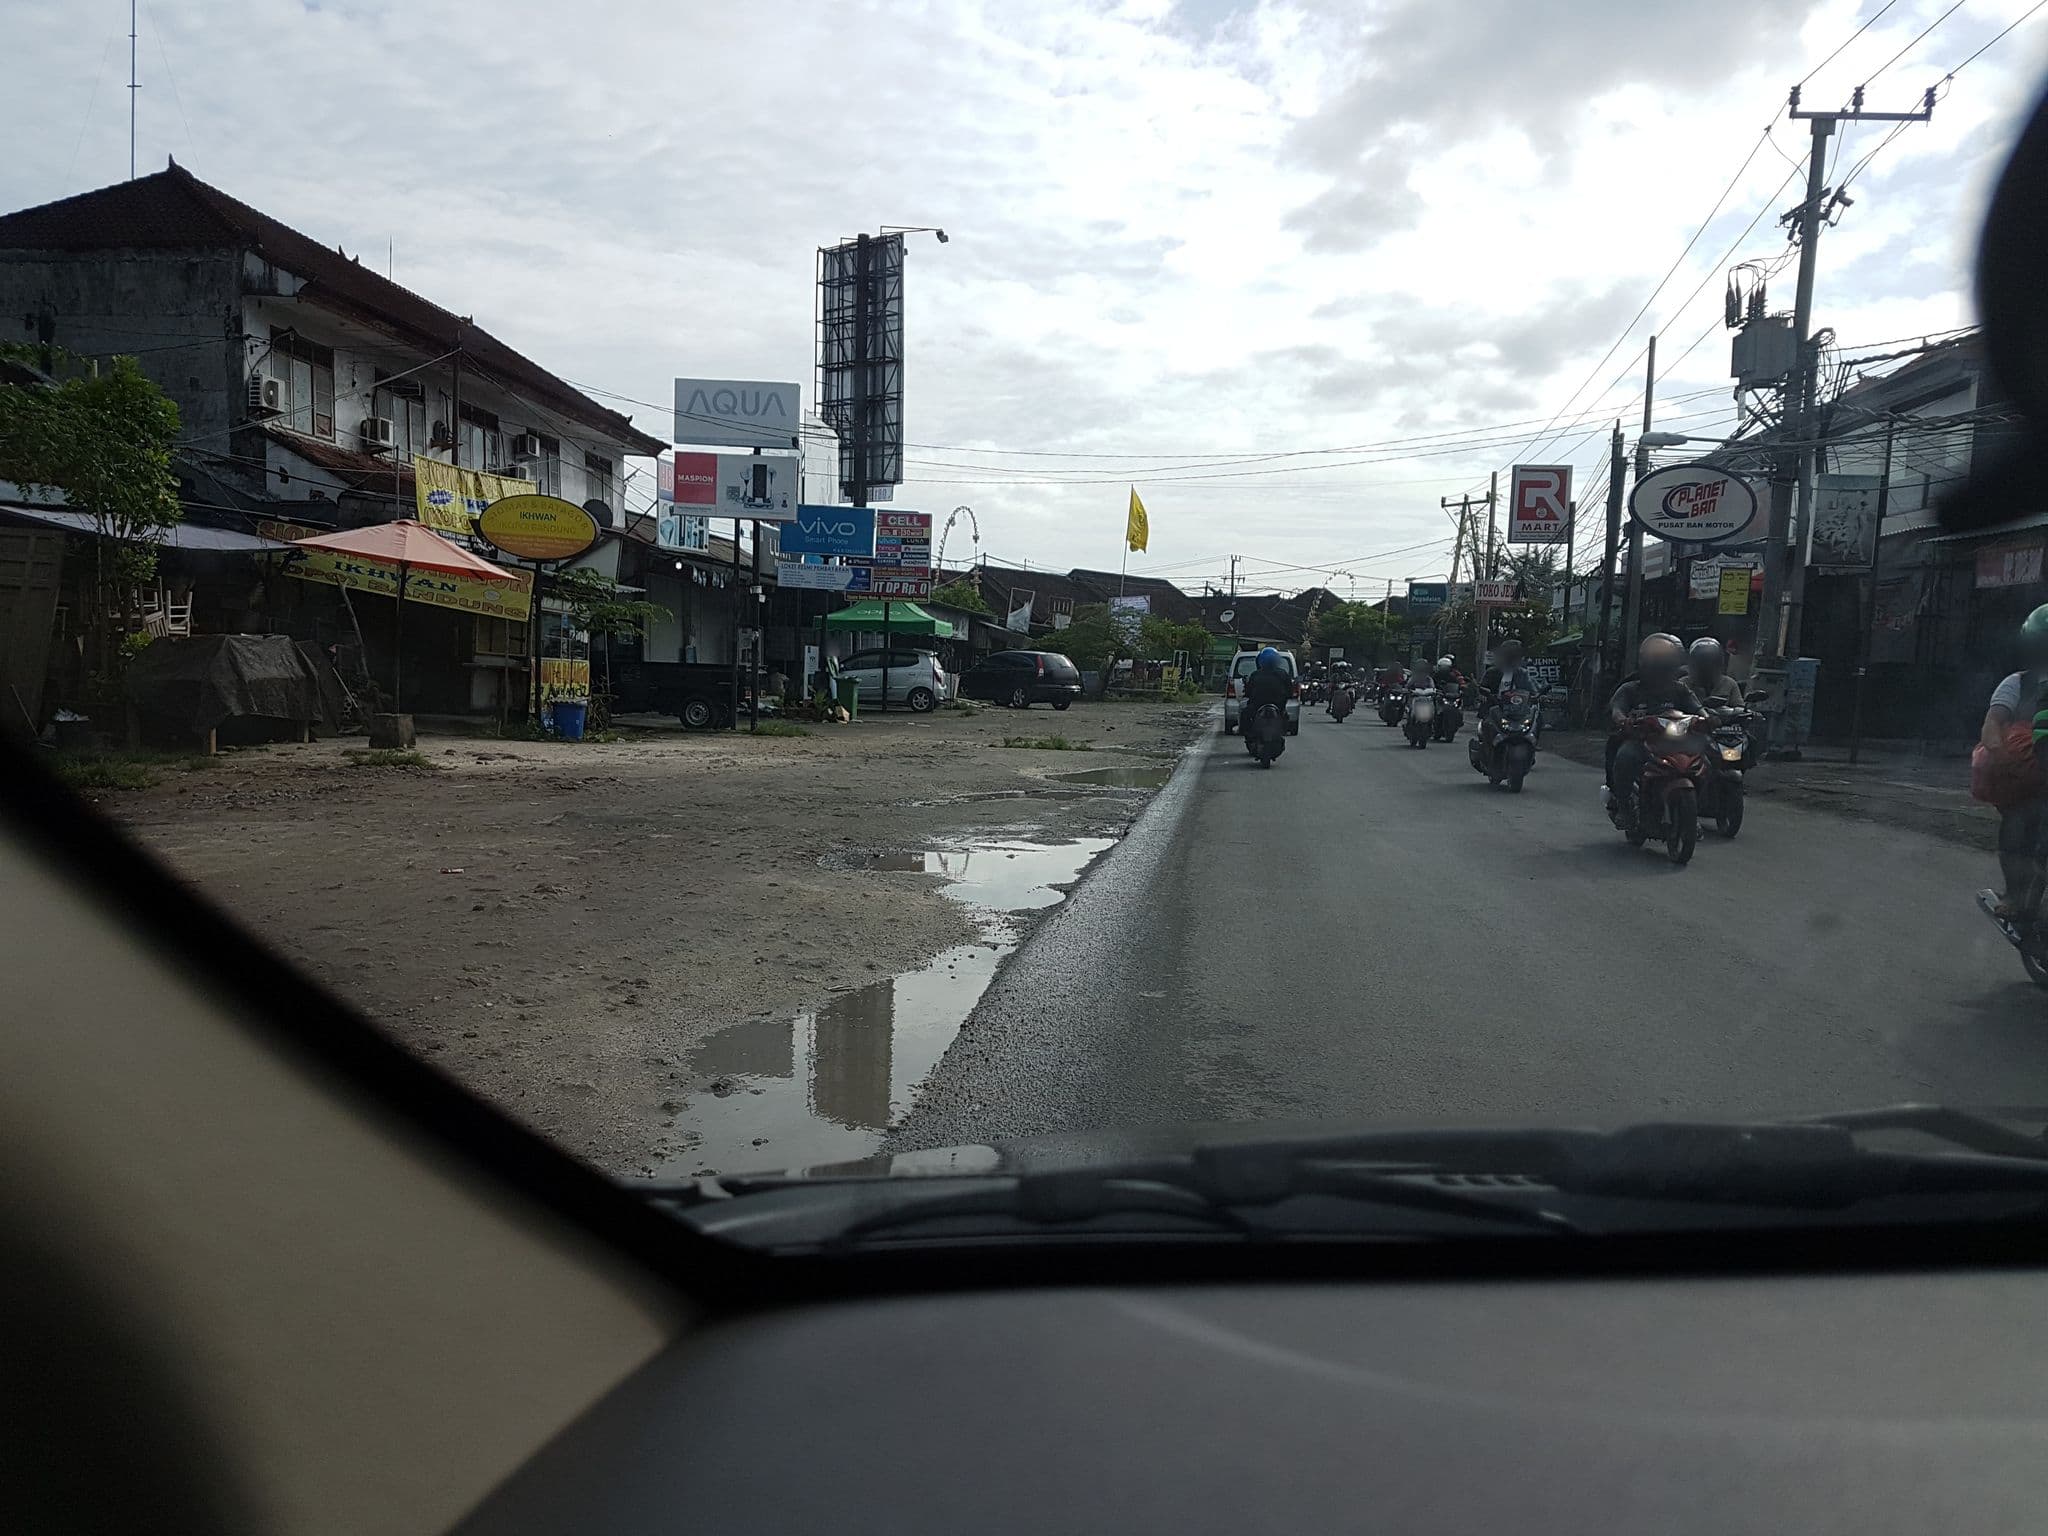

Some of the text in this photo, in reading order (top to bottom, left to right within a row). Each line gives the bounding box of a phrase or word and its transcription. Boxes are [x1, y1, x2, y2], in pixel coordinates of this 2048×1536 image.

[685, 387, 787, 417] AQUA
[677, 474, 714, 483] MASPION
[1677, 479, 1728, 507] PLANET
[1690, 499, 1717, 518] BAN
[519, 511, 557, 521] IKHWAN
[888, 515, 922, 526] CELL
[800, 516, 856, 537] vivo
[1521, 523, 1559, 531] MART
[804, 535, 849, 546] Smart Phone
[334, 560, 458, 593] IKHWAN
[886, 582, 900, 594] DP
[902, 583, 918, 596] Rp.
[921, 583, 928, 595] 0
[1478, 584, 1500, 598] TOKO
